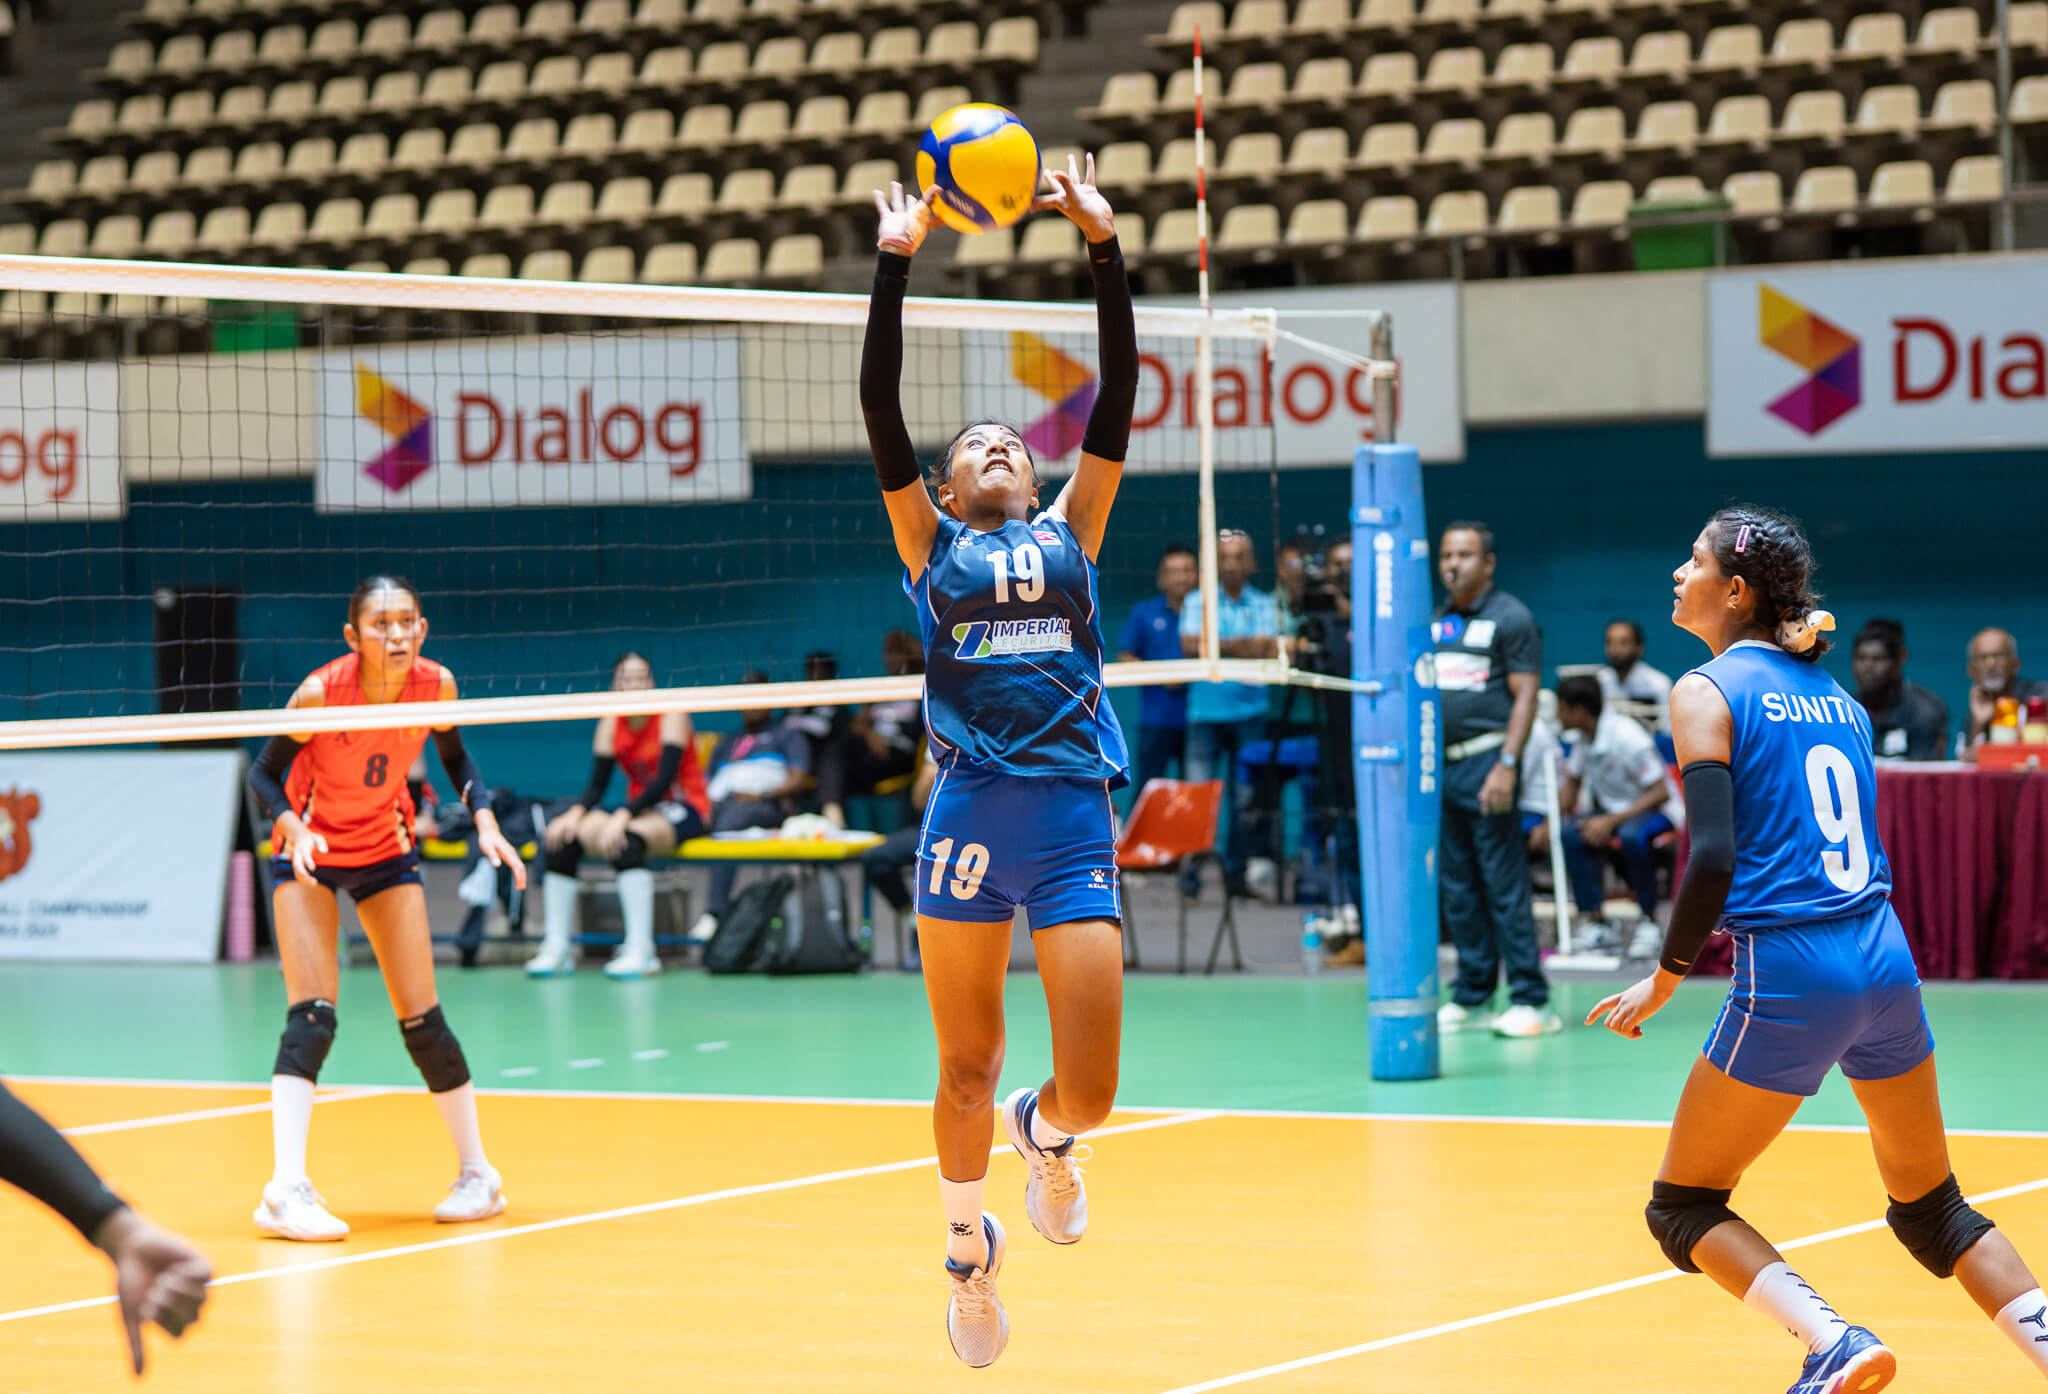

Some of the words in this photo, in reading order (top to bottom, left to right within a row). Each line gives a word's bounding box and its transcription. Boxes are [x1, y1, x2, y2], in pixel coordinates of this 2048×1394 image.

[1892, 318, 2048, 403] Dia
[457, 386, 703, 480] Dialog
[986, 543, 1045, 603] 19
[993, 619, 1071, 637] IMPERIAL
[363, 753, 388, 788] 8
[1805, 744, 1870, 893] 9
[929, 837, 990, 900] 19
